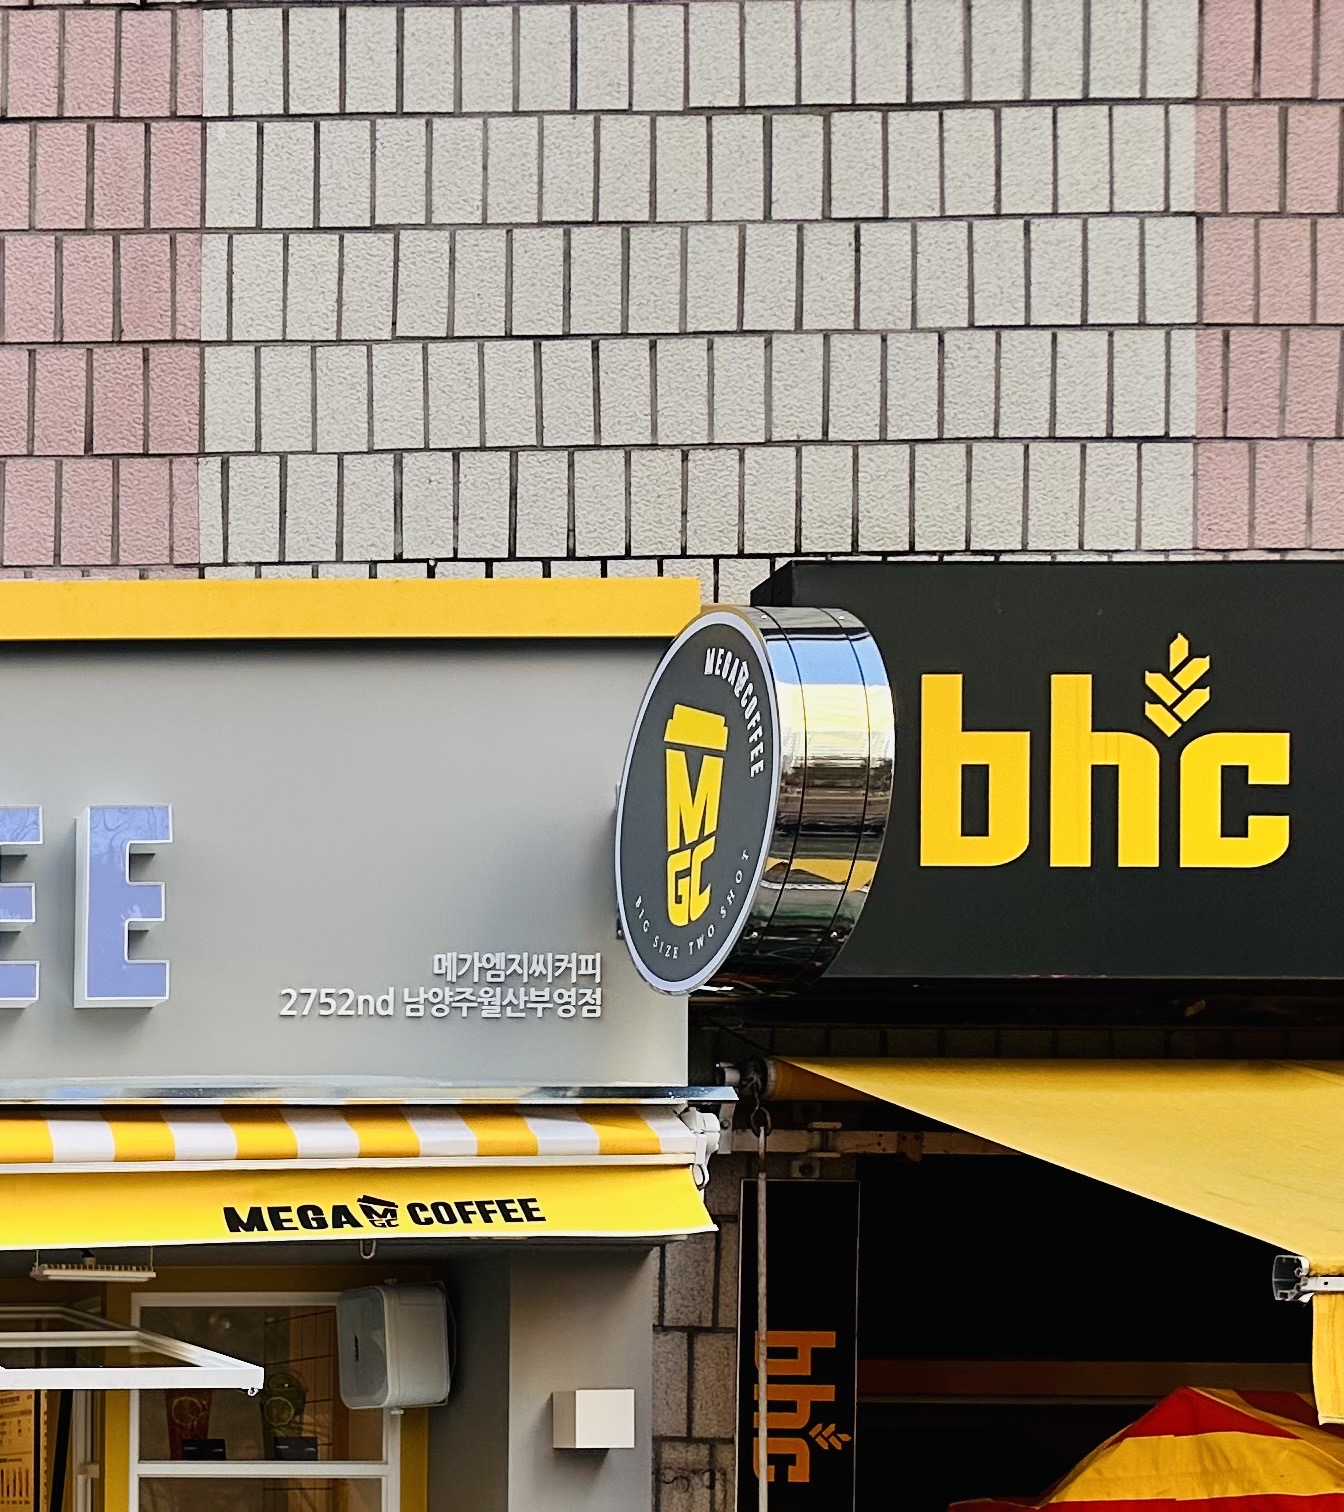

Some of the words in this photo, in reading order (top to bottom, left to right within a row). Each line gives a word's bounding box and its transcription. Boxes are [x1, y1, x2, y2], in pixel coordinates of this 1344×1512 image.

[704, 647, 739, 692] MEGA
[740, 683, 764, 778] COFFEE
[919, 673, 1291, 869] bhc
[653, 935, 679, 960] SIZE
[688, 927, 715, 956] TWO
[720, 850, 750, 919] SHOT
[279, 986, 396, 1019] 2752nd
[403, 985, 603, 1020] 남양주월산부영점
[431, 951, 602, 986] 메가엠지씨커피
[223, 1203, 364, 1233] MEGA
[406, 1198, 547, 1226] COFFEE
[751, 1330, 837, 1484] bhc
